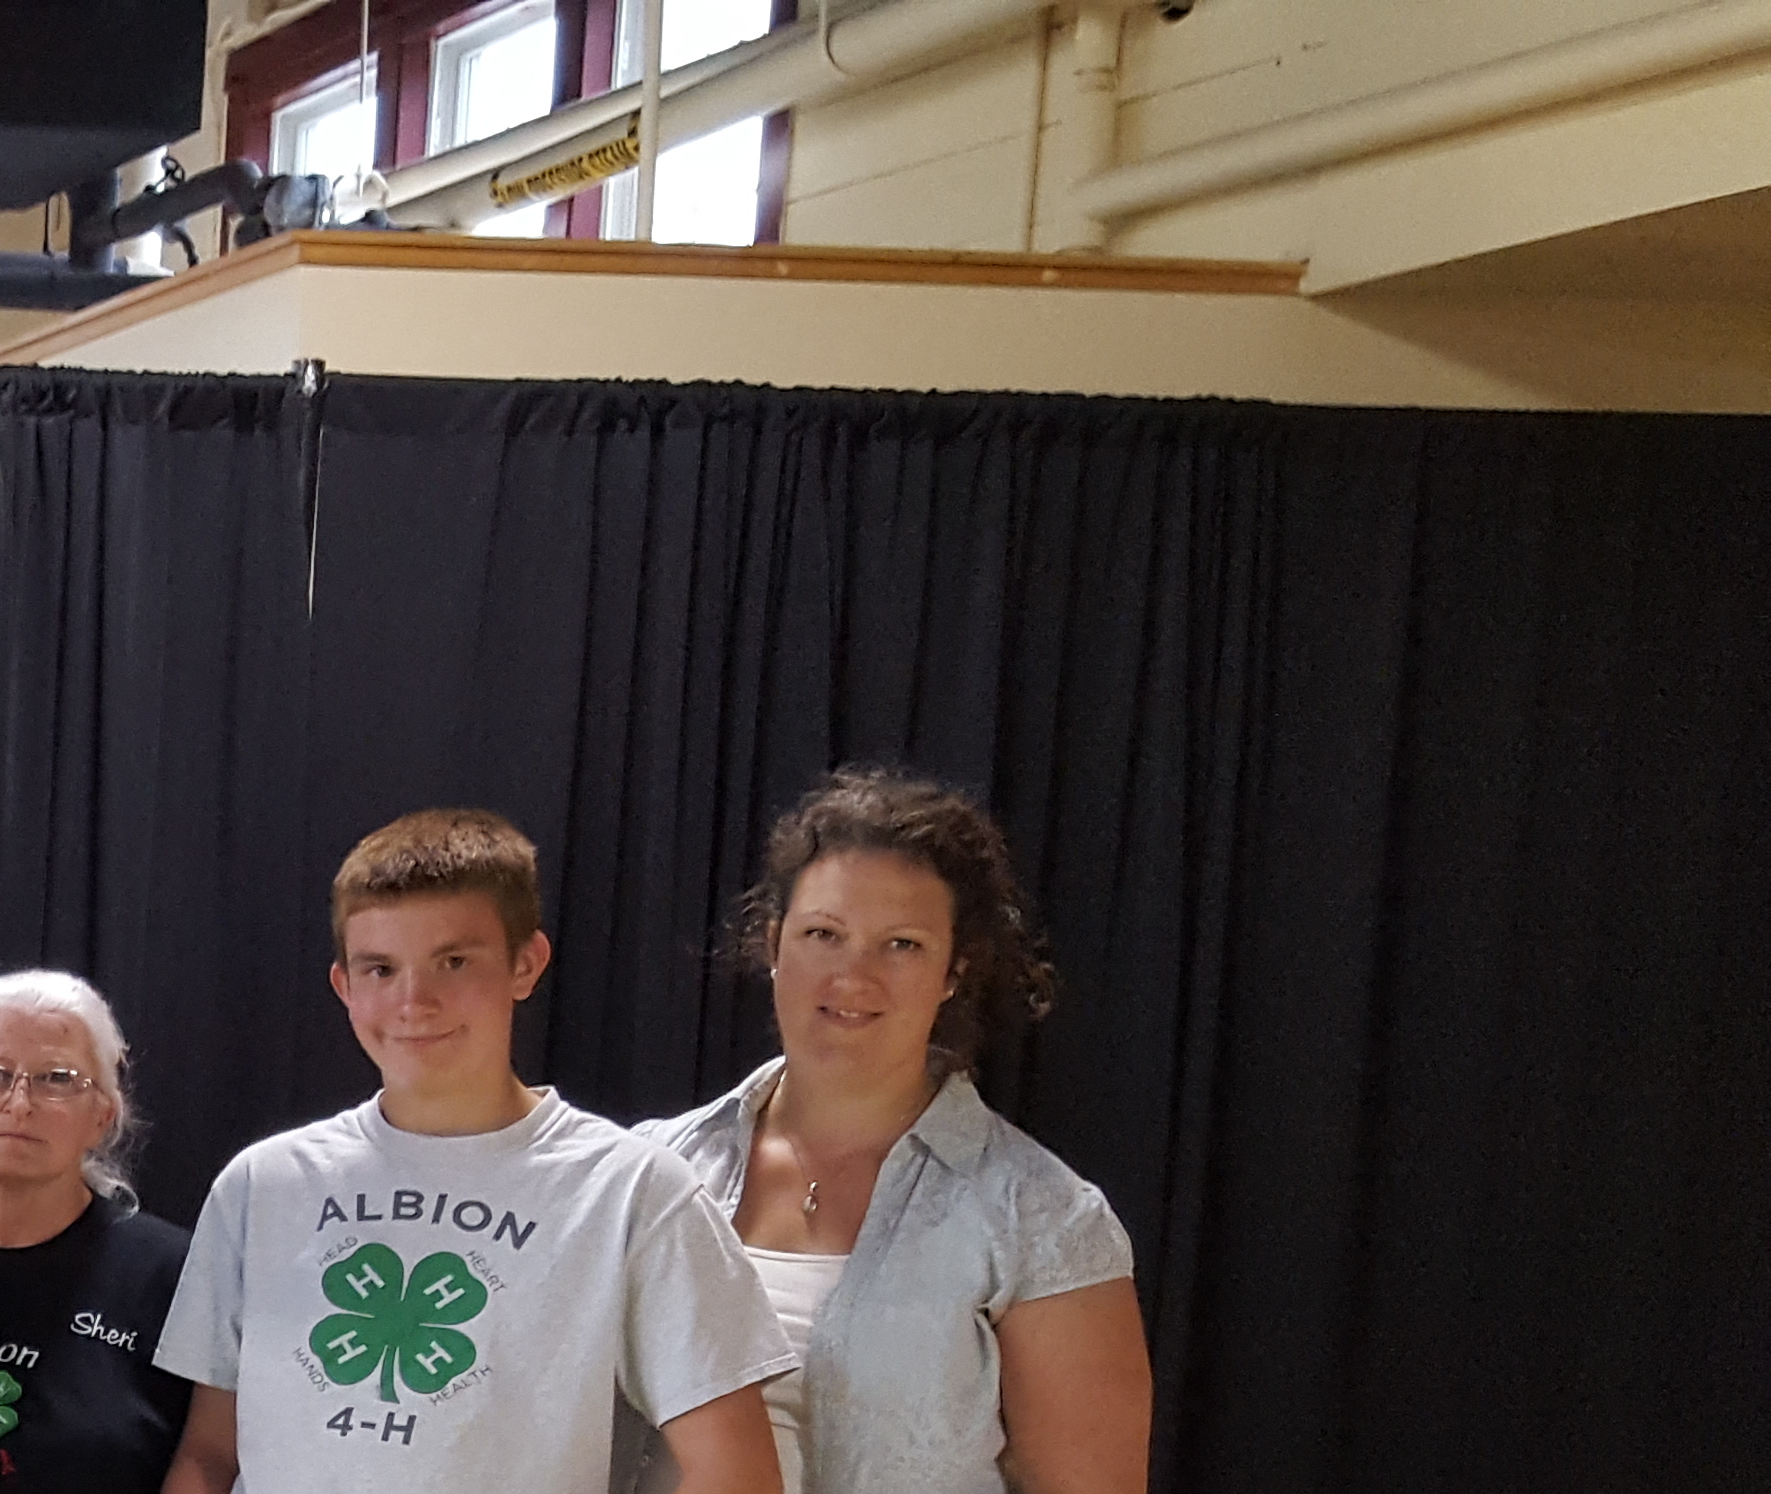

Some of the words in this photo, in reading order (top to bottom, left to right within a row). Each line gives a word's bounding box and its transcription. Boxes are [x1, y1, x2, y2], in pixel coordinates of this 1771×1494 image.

[316, 1189, 537, 1251] ALBION
[317, 1236, 358, 1268] HEAD
[345, 1263, 386, 1300] H
[423, 1274, 465, 1310] H
[466, 1250, 507, 1295] HEART
[70, 1312, 139, 1351] Sheri
[326, 1330, 368, 1365] H
[292, 1346, 331, 1393] HANDS
[415, 1340, 454, 1375] H
[429, 1364, 494, 1407] HEALTH
[326, 1406, 417, 1446] 4-H
